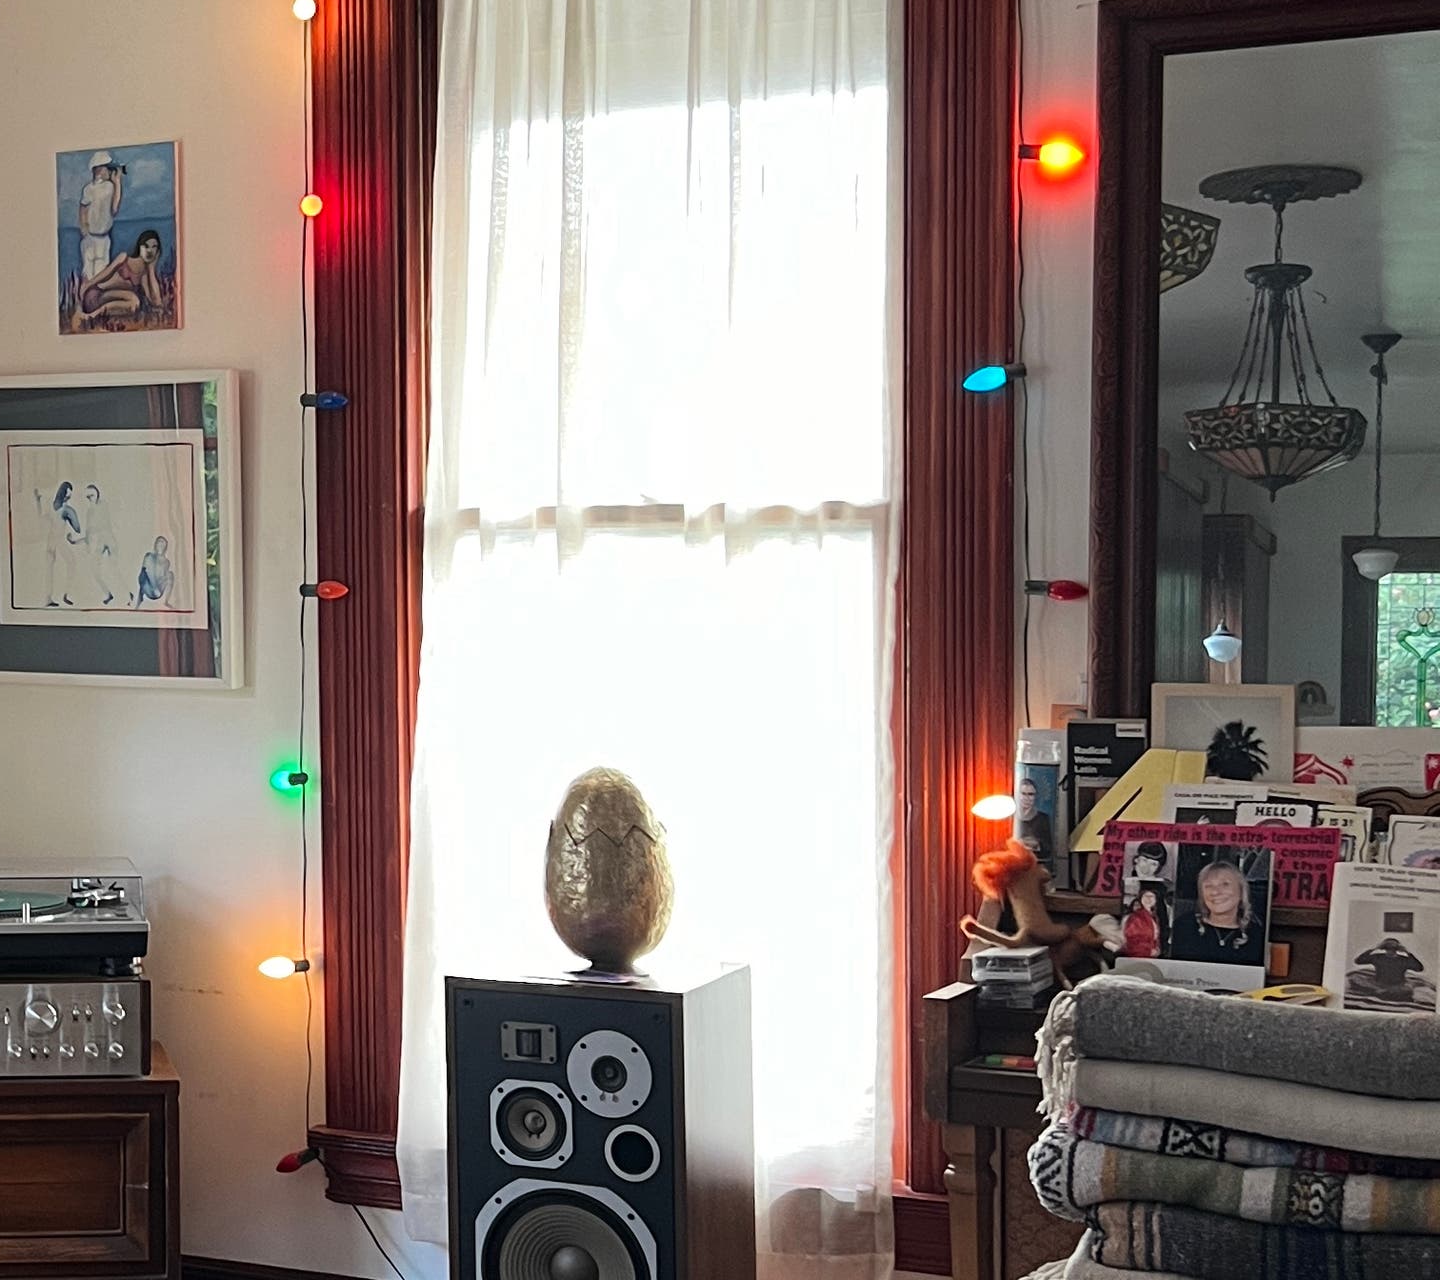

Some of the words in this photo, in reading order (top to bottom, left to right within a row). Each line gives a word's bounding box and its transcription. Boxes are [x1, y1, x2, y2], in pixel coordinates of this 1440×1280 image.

[1074, 745, 1108, 755] Radical
[1255, 806, 1297, 817] HELLO
[1106, 824, 1123, 842] My
[1127, 826, 1160, 839] other
[1163, 827, 1187, 840] ride
[1191, 828, 1201, 840] is
[1206, 828, 1226, 842] the
[1271, 831, 1335, 845] terrestrial
[1281, 849, 1334, 859] cosmic
[1293, 861, 1327, 872] the
